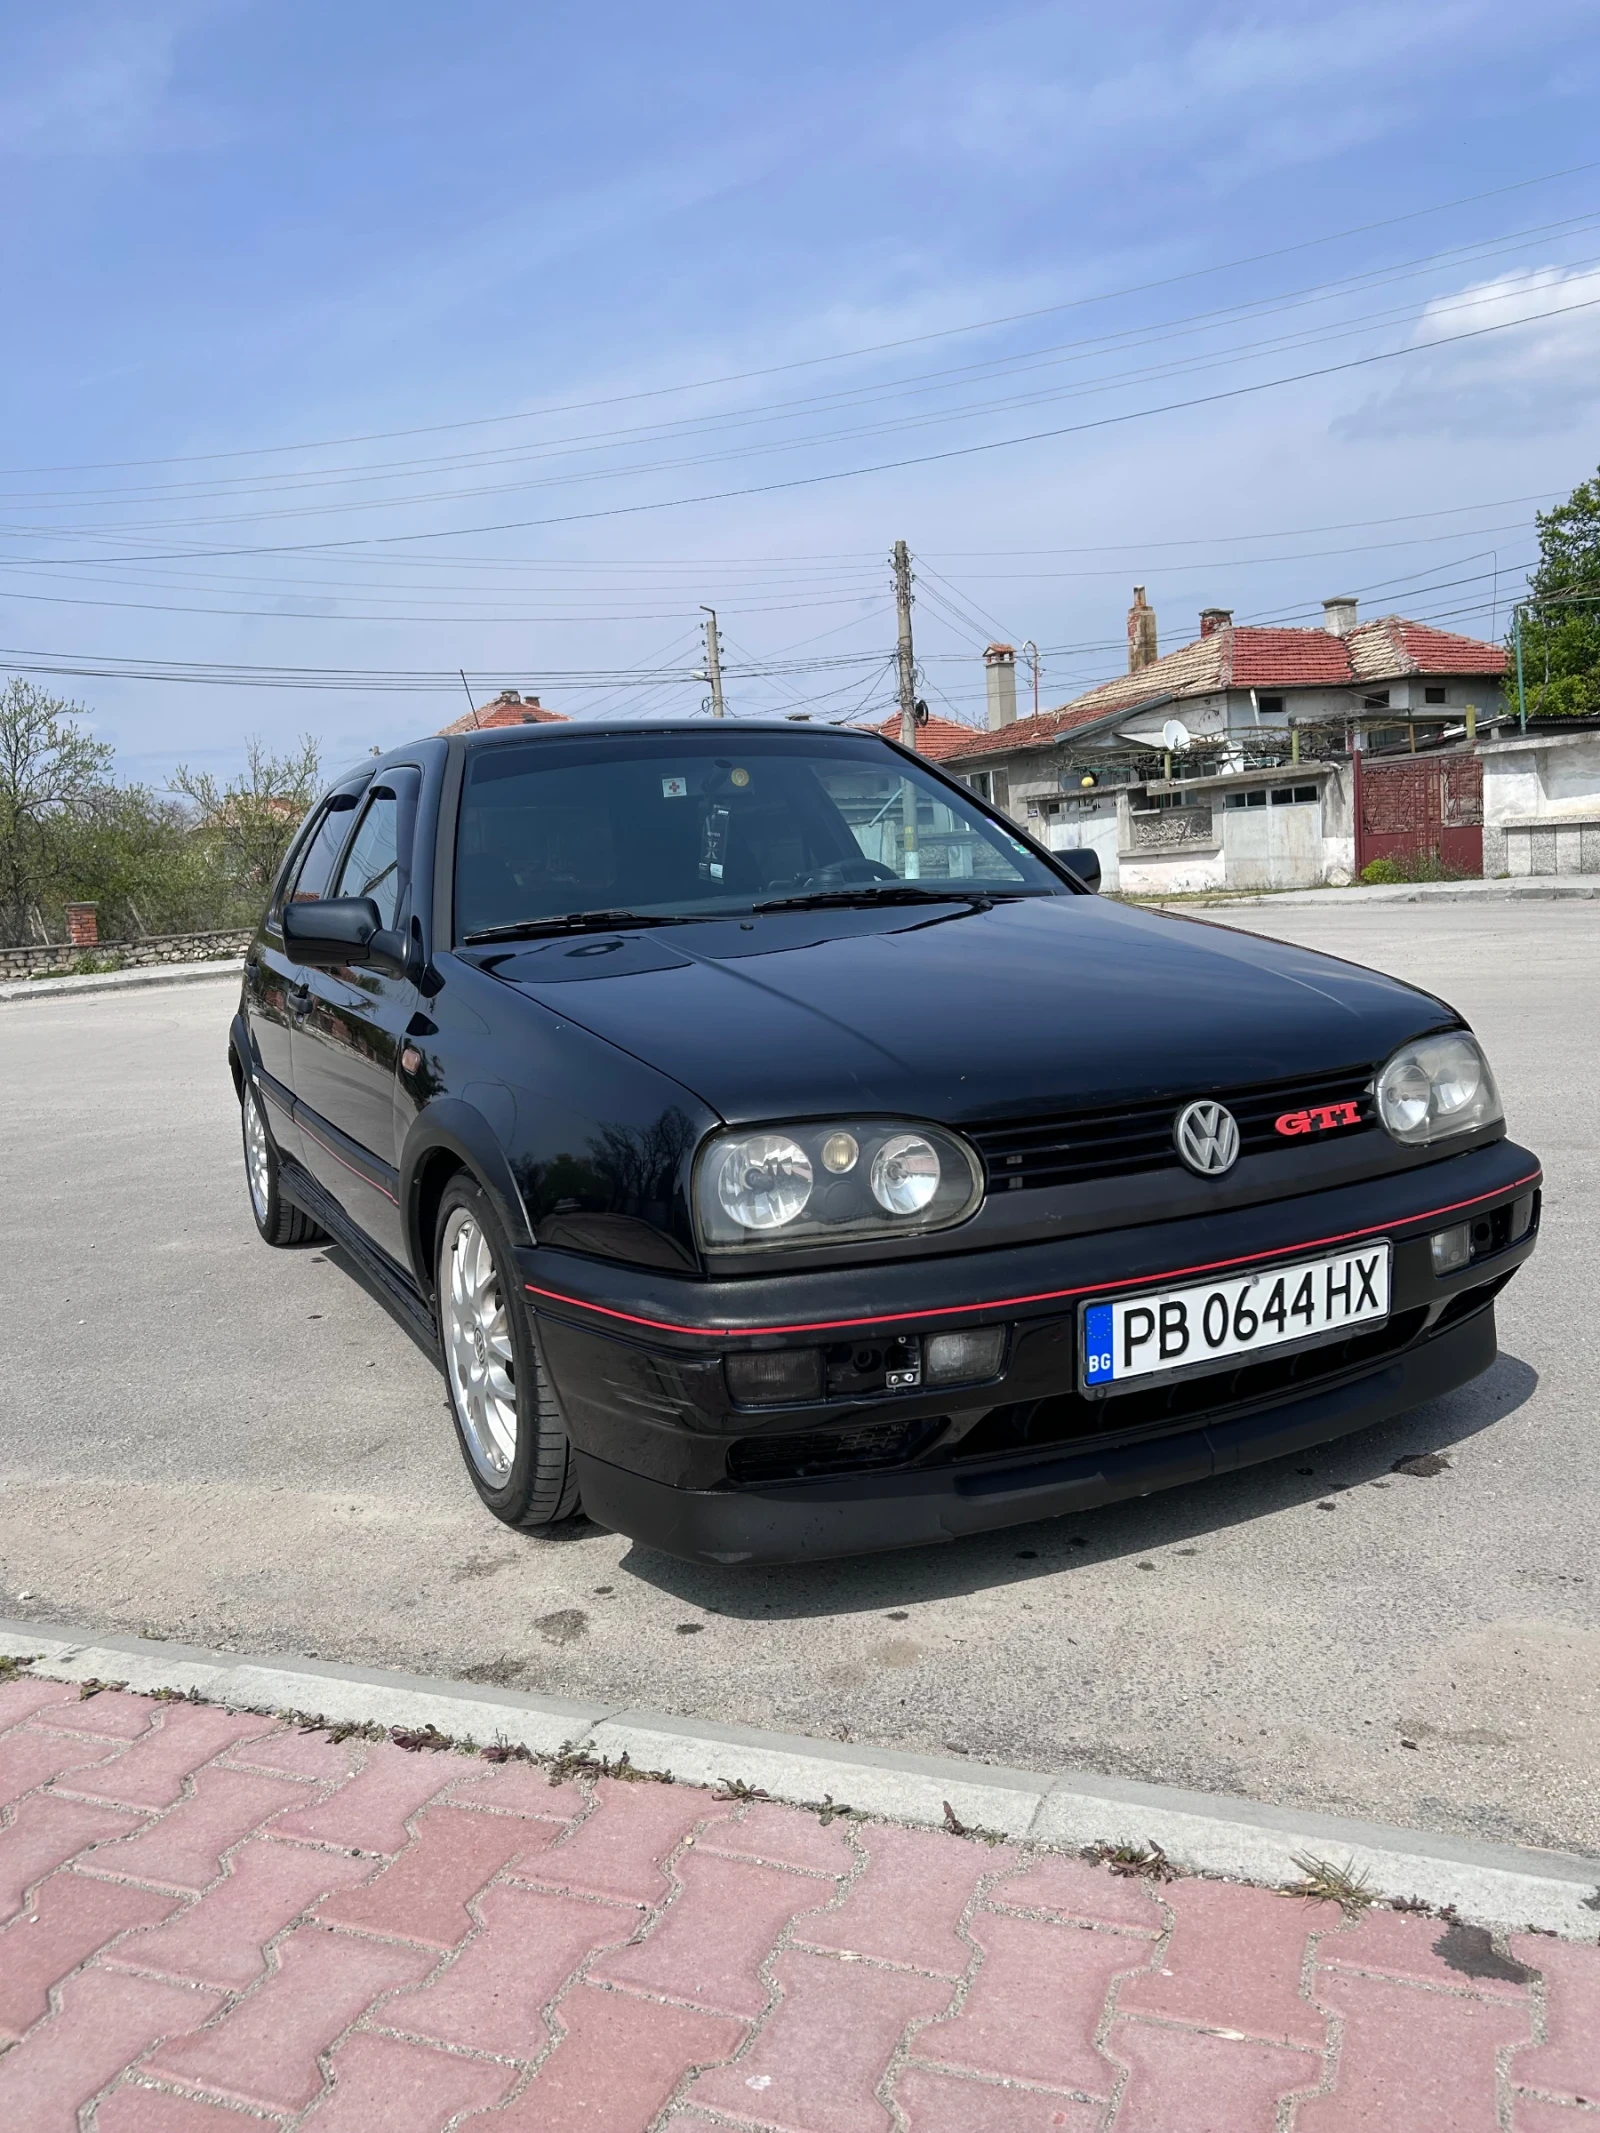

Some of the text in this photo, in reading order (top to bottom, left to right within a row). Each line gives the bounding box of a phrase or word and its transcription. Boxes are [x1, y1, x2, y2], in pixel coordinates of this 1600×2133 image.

[1180, 1101, 1240, 1174] VW
[1275, 1101, 1362, 1136] GTI
[1124, 1254, 1380, 1367] PB 0644 HX
[1089, 1353, 1111, 1373] BG
